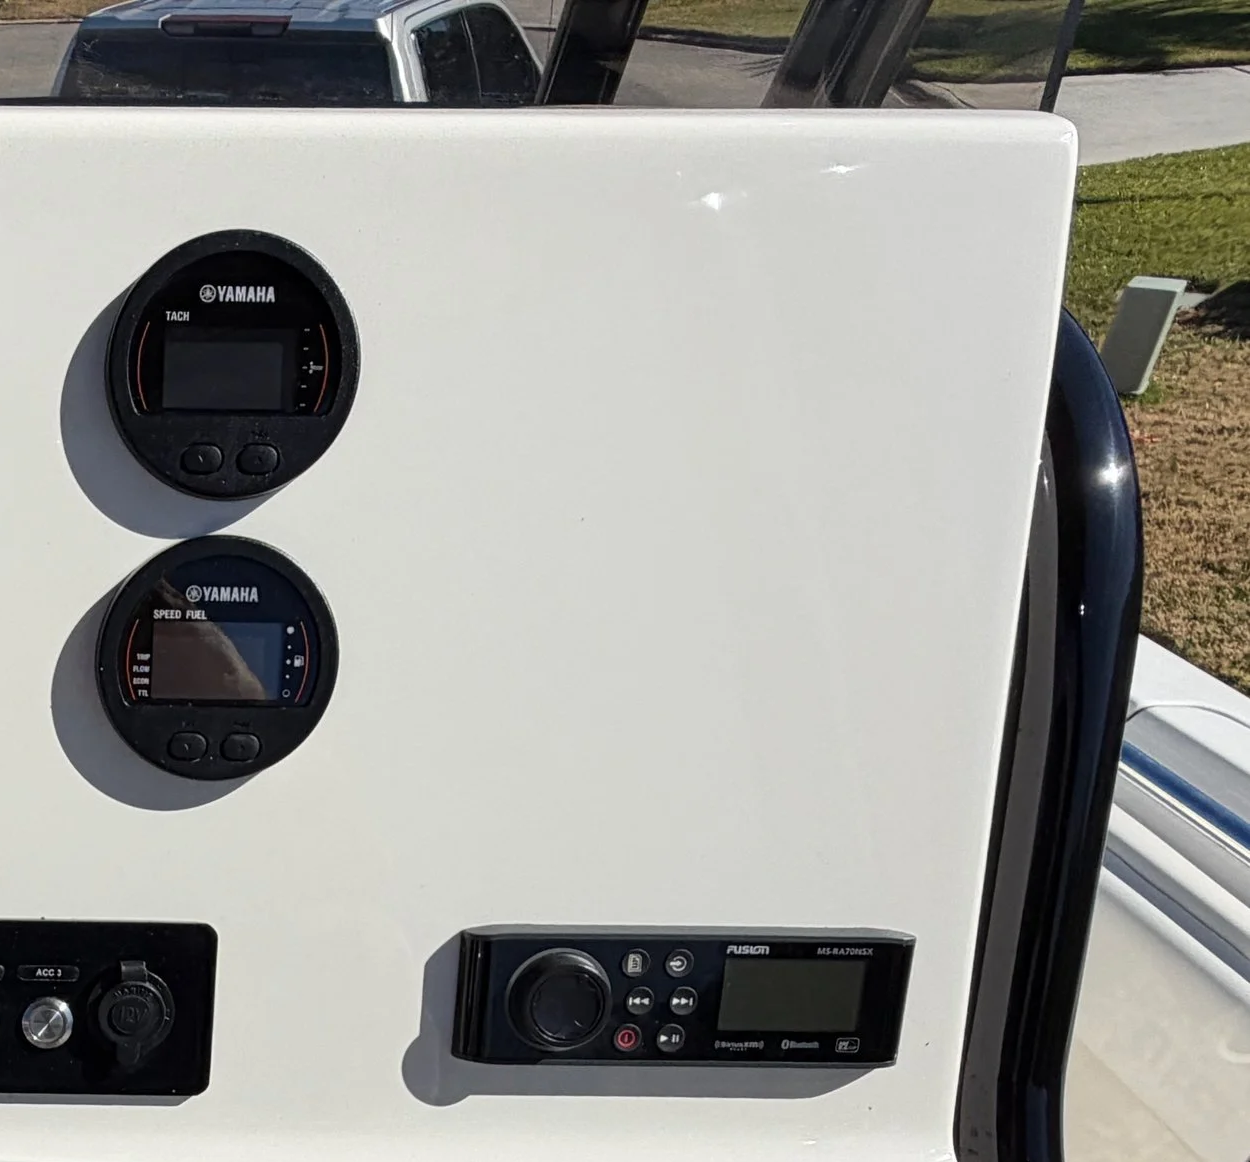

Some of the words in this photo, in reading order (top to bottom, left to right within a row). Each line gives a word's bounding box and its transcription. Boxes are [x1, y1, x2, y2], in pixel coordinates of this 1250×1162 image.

[217, 286, 276, 303] YAMAHA
[166, 310, 190, 321] TACH
[203, 586, 259, 603] YAMAHA
[153, 609, 182, 620] SPEED
[186, 610, 208, 620] FUEL
[36, 968, 53, 977] ACC
[55, 968, 62, 978] 3
